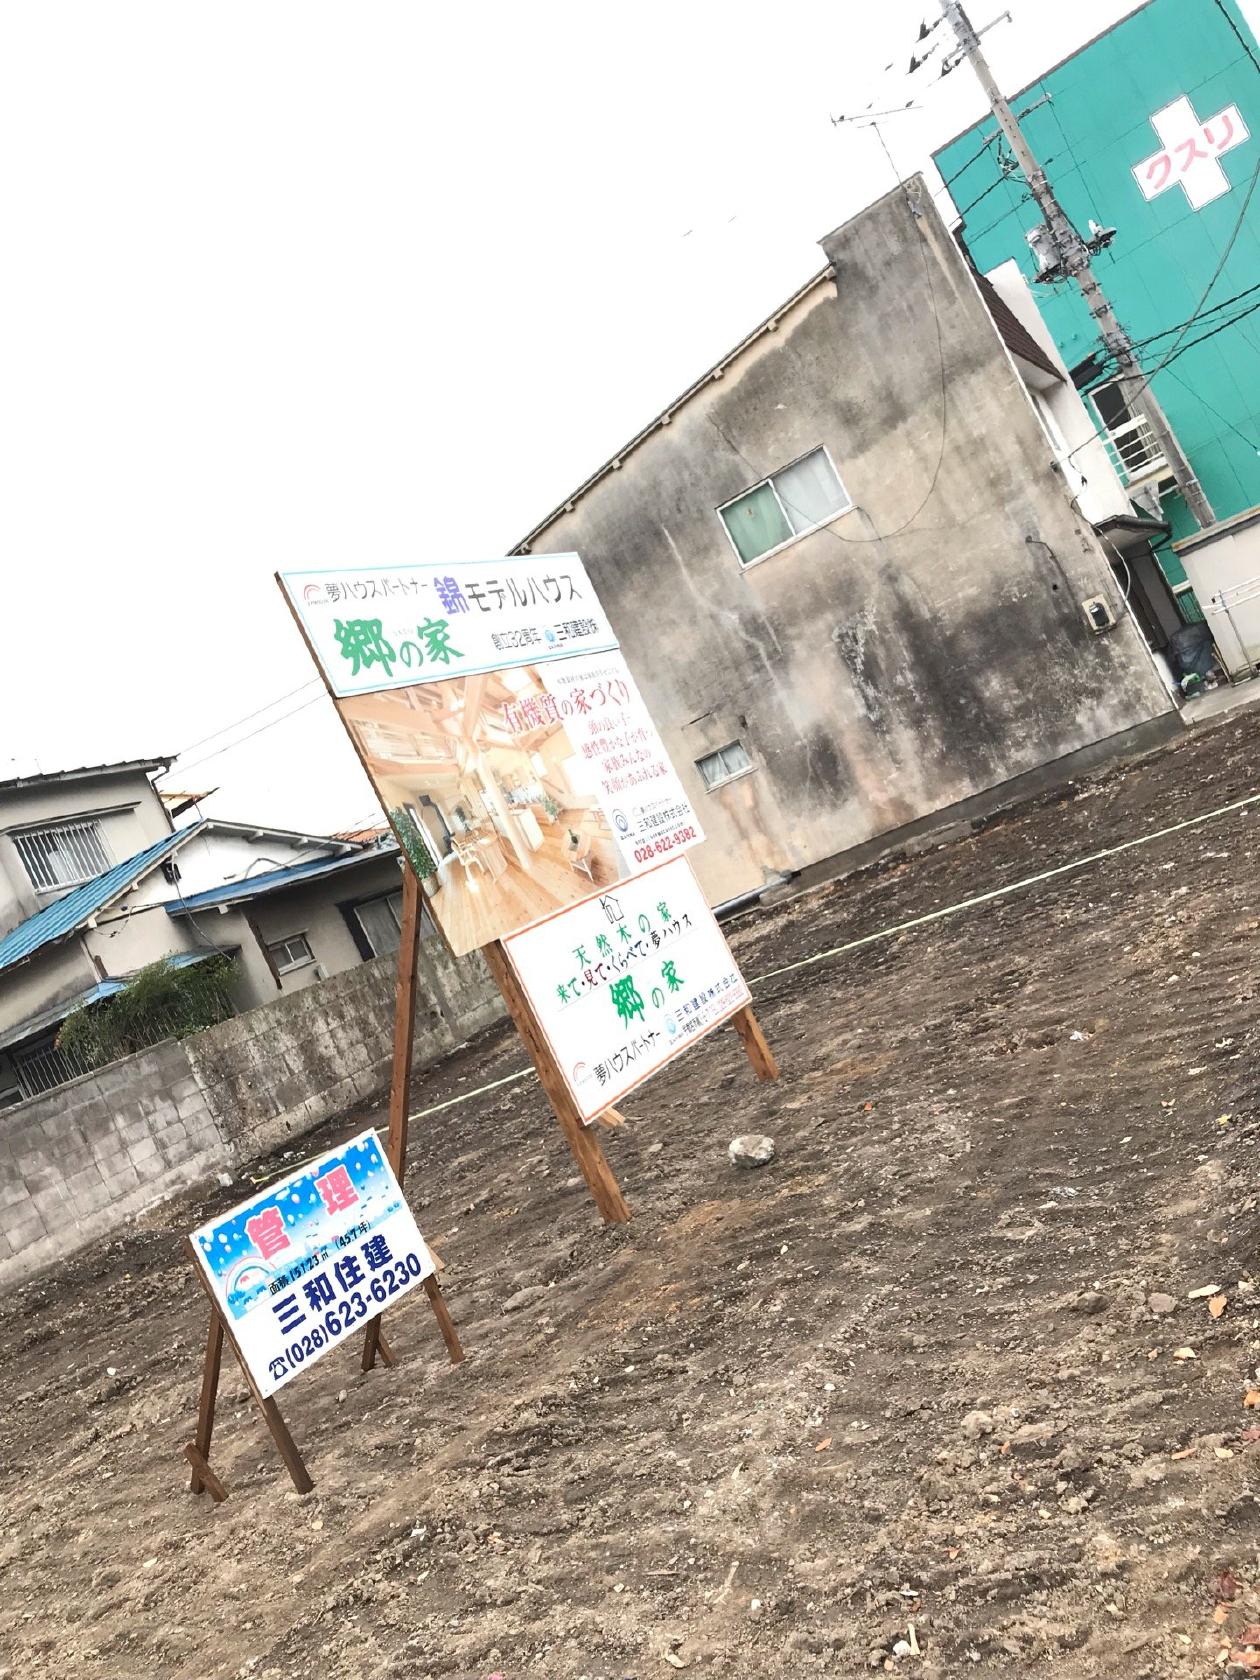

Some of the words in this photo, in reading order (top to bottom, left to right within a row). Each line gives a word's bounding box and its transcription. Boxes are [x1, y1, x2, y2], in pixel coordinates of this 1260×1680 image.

[1145, 114, 1234, 190] クスリ
[324, 578, 428, 603] 夢ハウスパートナー
[433, 574, 582, 615] 錦モデルハウス
[333, 617, 465, 678] 郷の家
[502, 679, 631, 734] 有機質の家づくり
[633, 826, 697, 863] 028-622-9382
[572, 901, 672, 970] 天然木の家
[608, 960, 685, 1030] 郷の家
[592, 1030, 661, 1087] 夢ハウスパートナー
[246, 1166, 360, 1261] 管理
[271, 1234, 393, 1336] 三和住建
[284, 1252, 422, 1369] (028)623-6230
